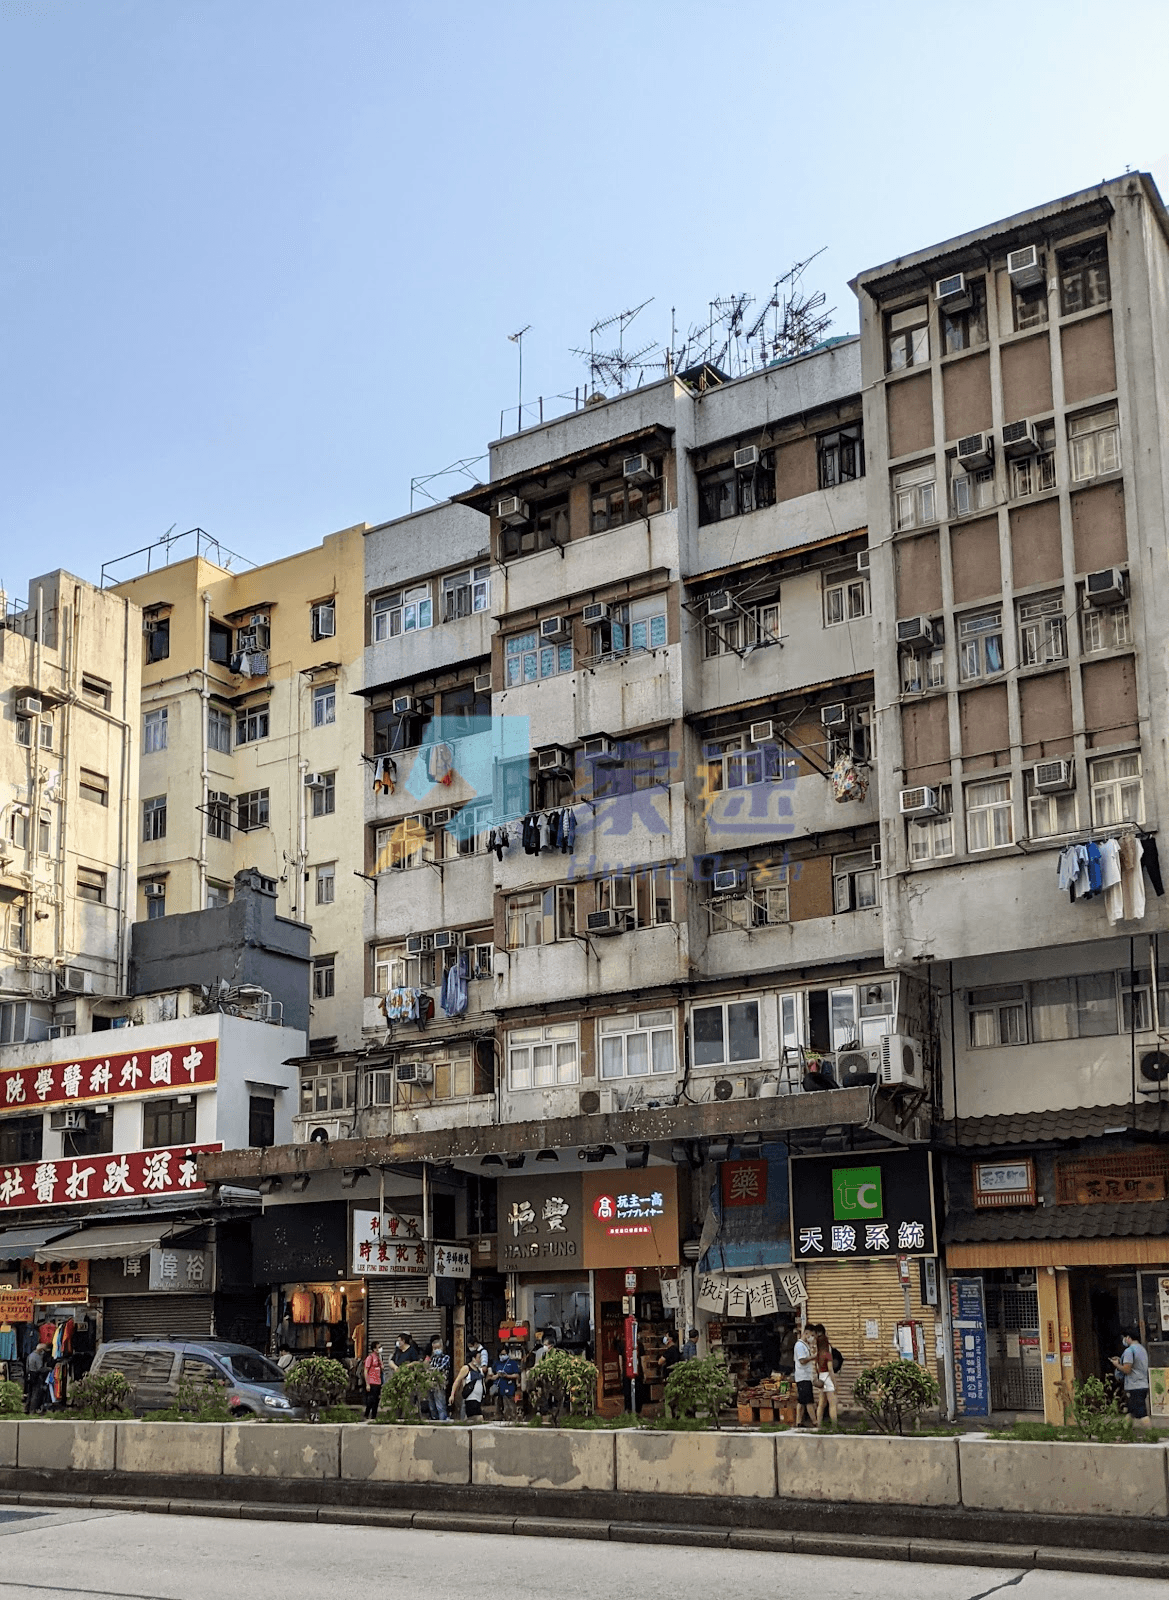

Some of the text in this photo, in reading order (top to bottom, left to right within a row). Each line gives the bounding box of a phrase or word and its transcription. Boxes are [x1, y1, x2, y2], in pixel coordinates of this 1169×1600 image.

[730, 1166, 760, 1199] 藥
[616, 1192, 663, 1208] 玩主一高
[504, 1240, 577, 1259] HANG FUNG
[800, 1221, 925, 1253] 天駿系統
[359, 1240, 427, 1264] 時裝批發
[159, 1252, 205, 1281] 偉裕
